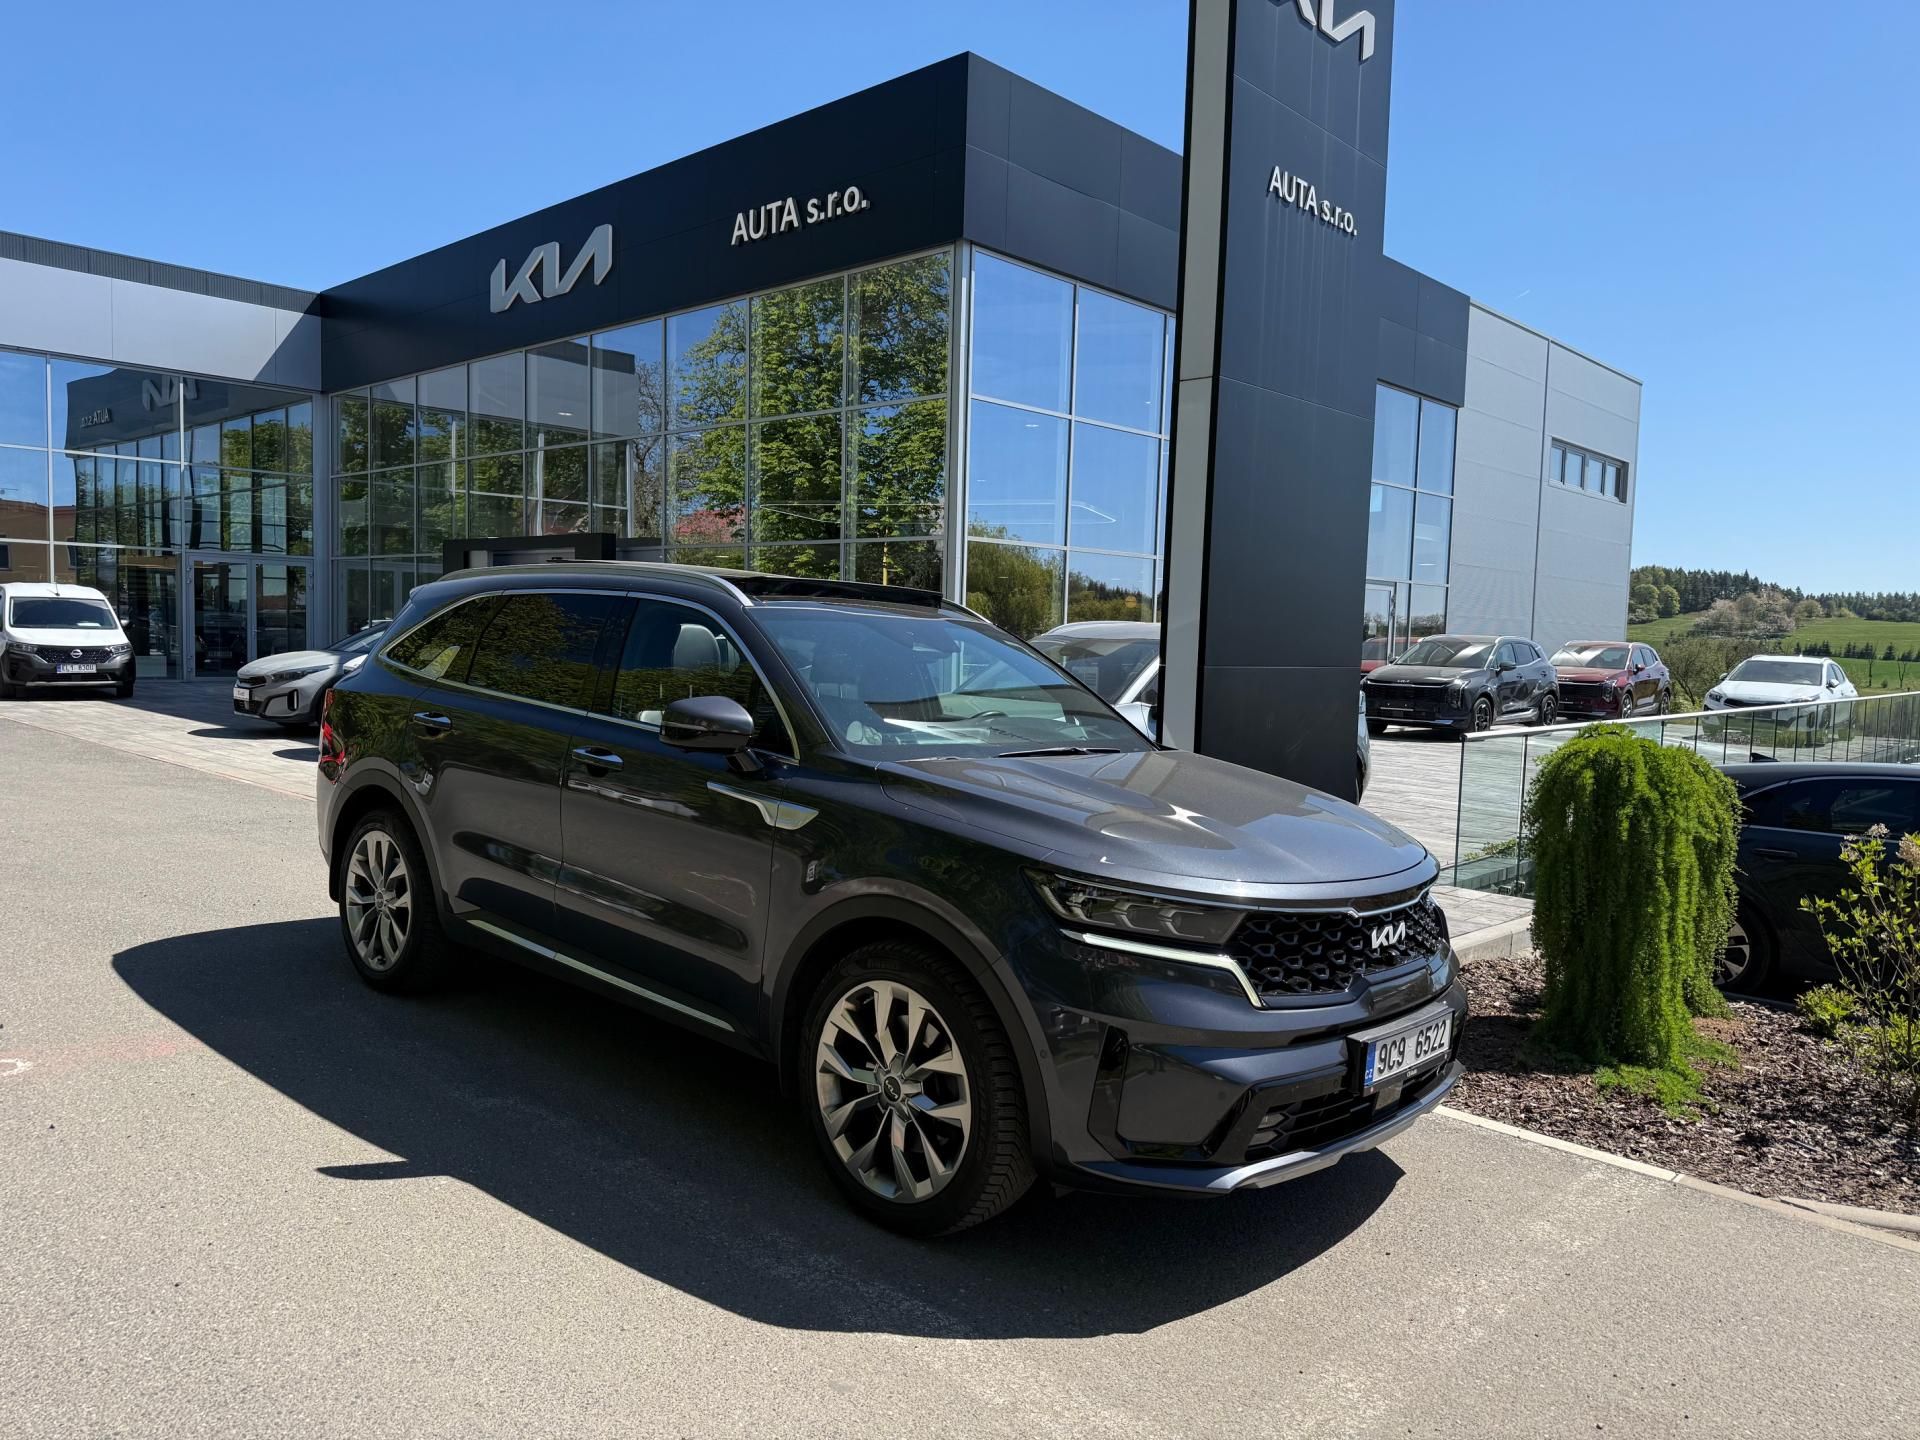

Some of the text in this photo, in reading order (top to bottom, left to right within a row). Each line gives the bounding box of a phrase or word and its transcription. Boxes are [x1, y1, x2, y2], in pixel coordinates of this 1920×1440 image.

[731, 185, 870, 247] AUTA s.r.o.
[1269, 165, 1358, 236] AUTA s.r.o.
[489, 223, 613, 314] KIA
[1371, 920, 1406, 949] KIA
[1364, 1069, 1373, 1080] CZ
[1378, 1019, 1447, 1075] 9C9 6522
